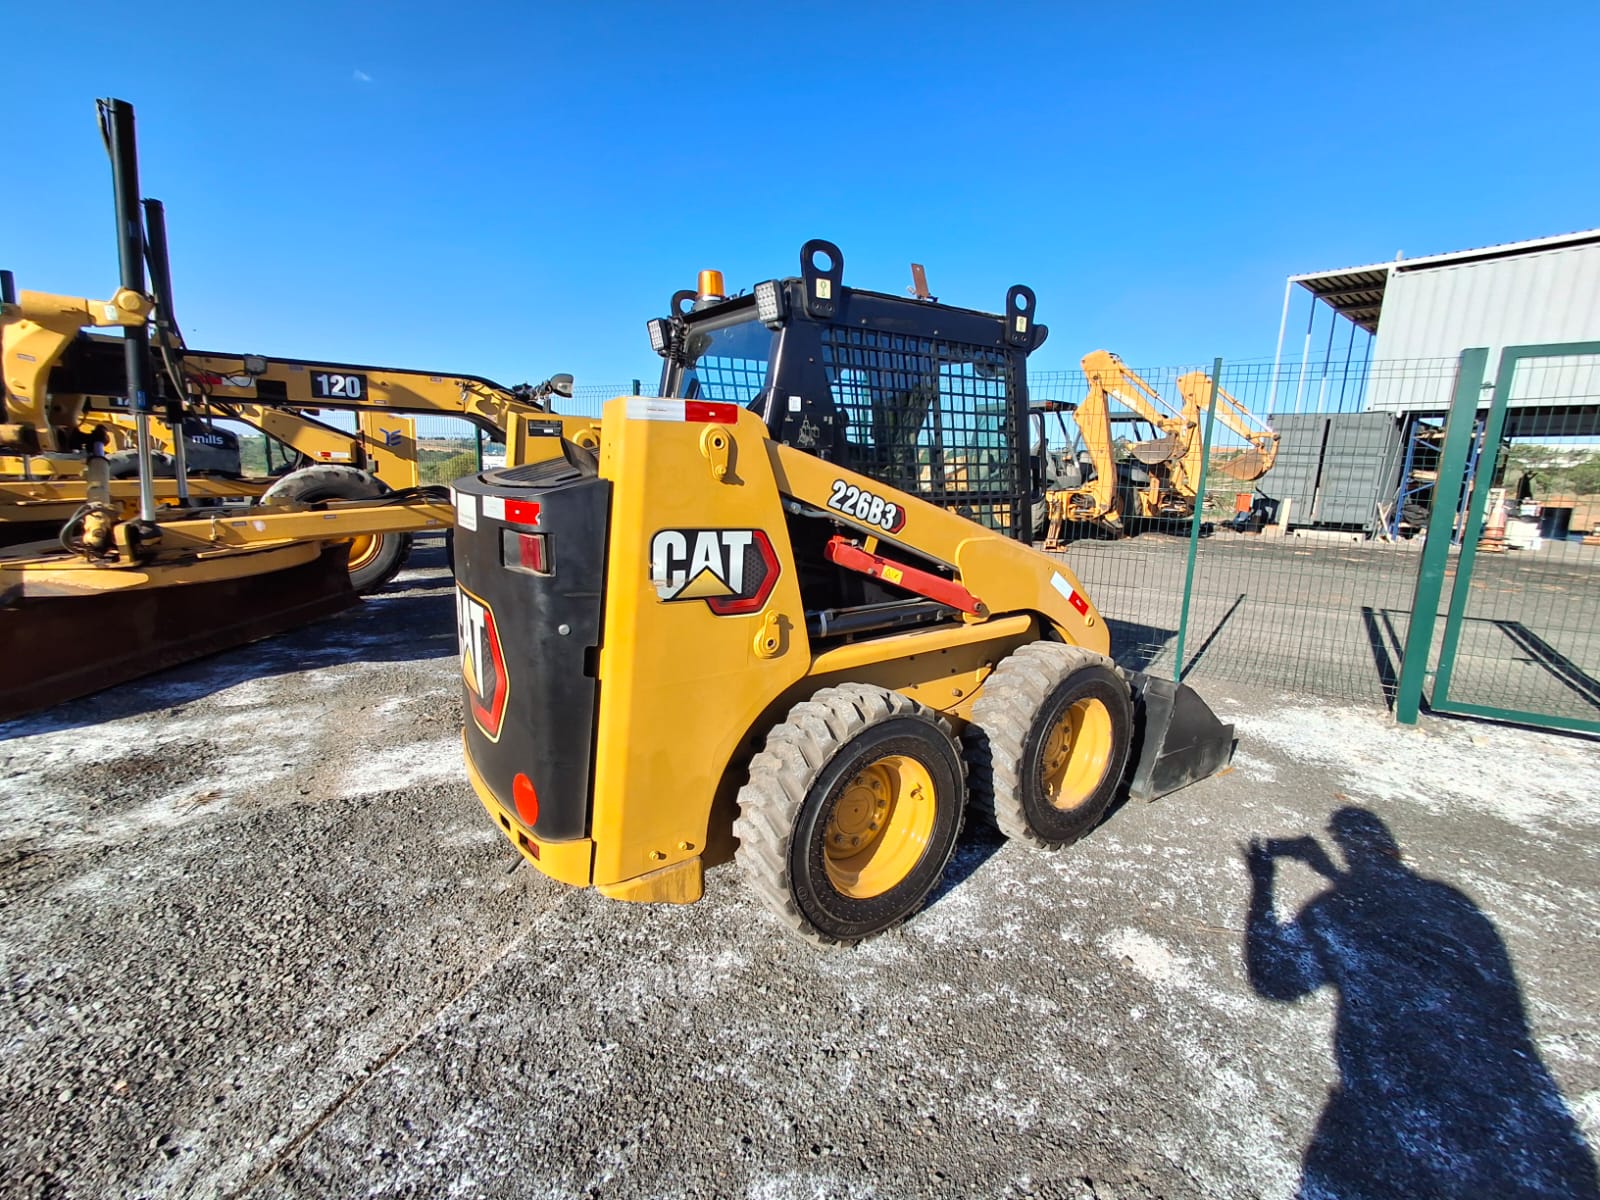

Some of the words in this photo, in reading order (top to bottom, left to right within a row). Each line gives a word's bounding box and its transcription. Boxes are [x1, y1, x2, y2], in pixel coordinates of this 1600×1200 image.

[317, 374, 361, 398] 120
[192, 432, 224, 445] mills
[827, 479, 897, 531] 226B3
[652, 530, 753, 600] CAT
